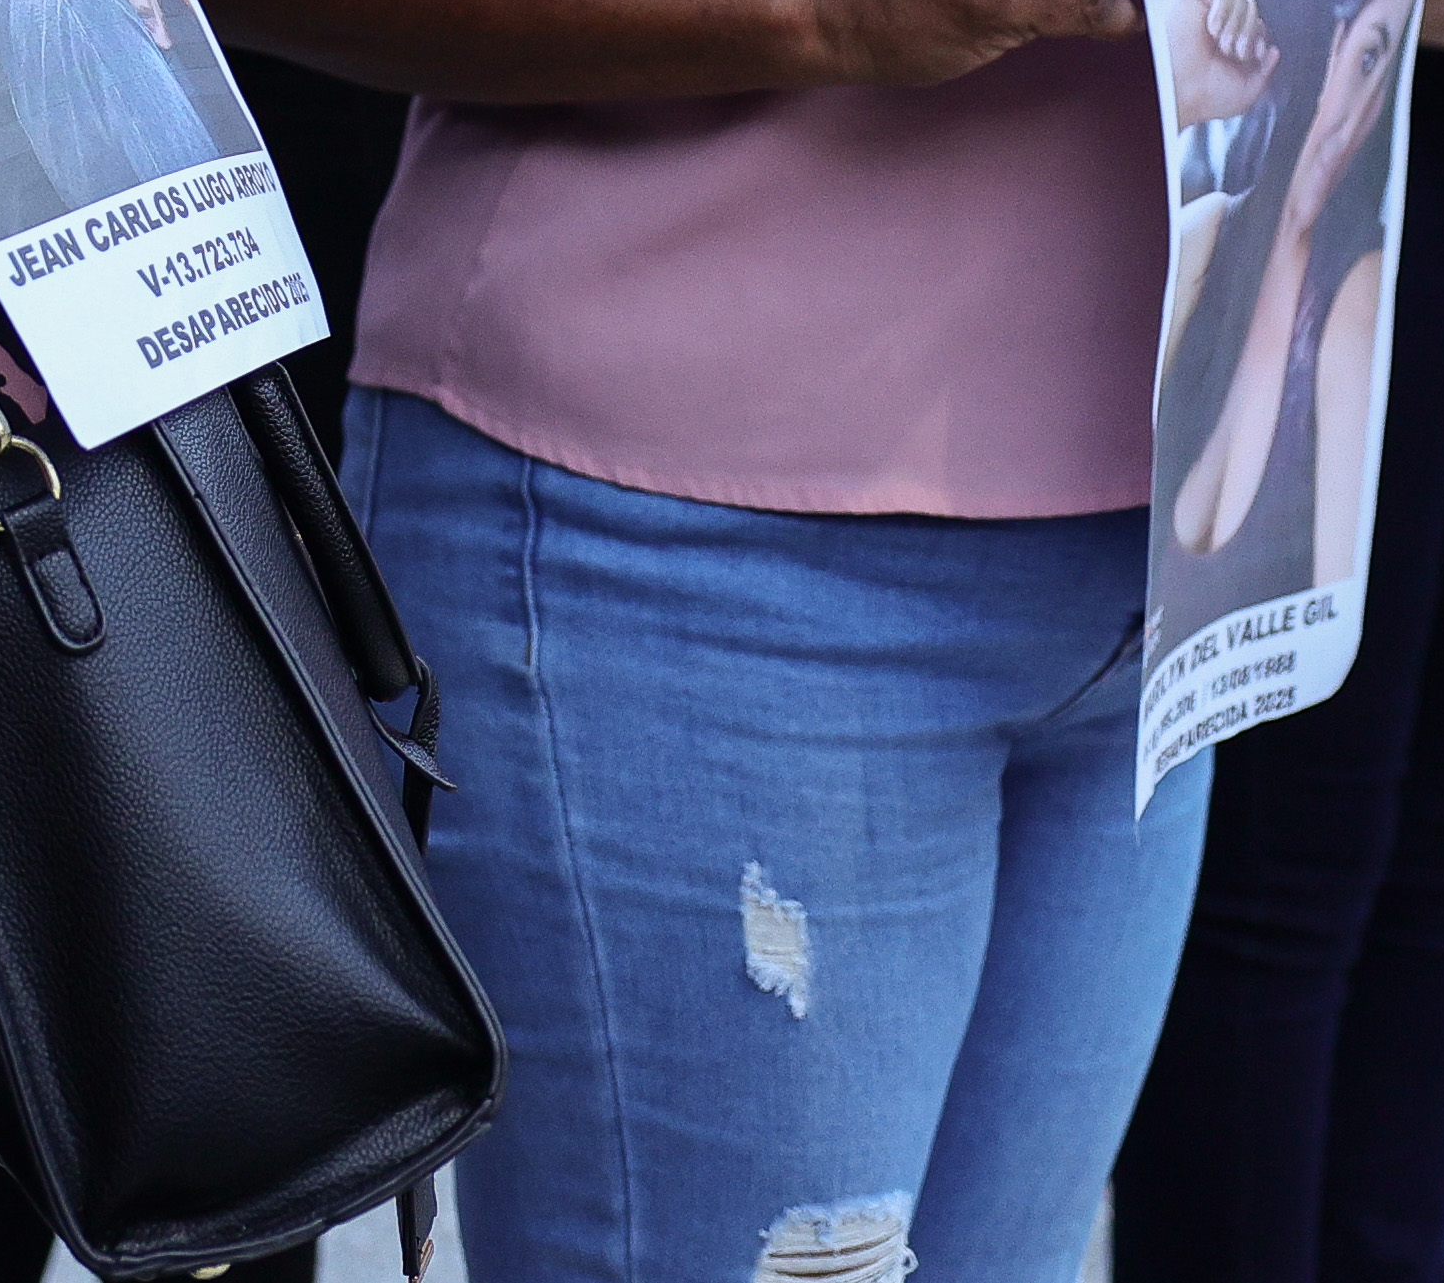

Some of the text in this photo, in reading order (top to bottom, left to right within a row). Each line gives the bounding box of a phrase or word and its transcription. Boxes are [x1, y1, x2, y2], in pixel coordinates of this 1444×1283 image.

[7, 161, 277, 288] JEAN CARLOS LUGO ARROYO
[136, 226, 262, 298] V-13.723.734
[135, 280, 291, 370] DESAPARECIDO
[1226, 604, 1297, 652] VALLE
[1302, 594, 1339, 629] GIL
